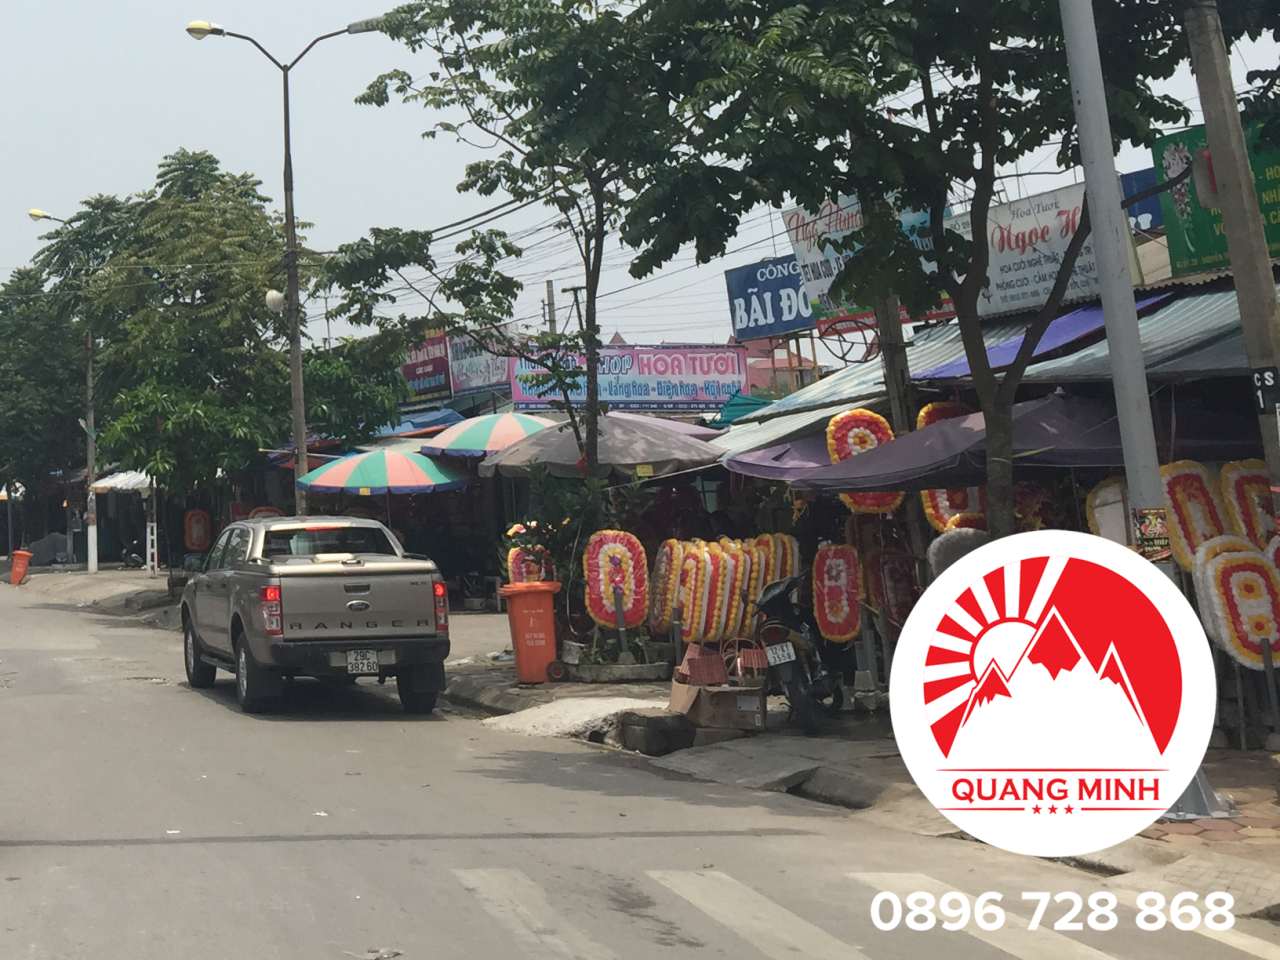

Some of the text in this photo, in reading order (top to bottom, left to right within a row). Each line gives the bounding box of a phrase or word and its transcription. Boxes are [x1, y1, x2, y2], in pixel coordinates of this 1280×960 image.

[1010, 208, 1032, 221] Hoa
[991, 223, 1052, 255] Ngọc
[756, 261, 800, 282] CÔNG
[733, 287, 775, 330] BÃI
[638, 352, 686, 376] HOA
[687, 351, 741, 376] TƯƠI
[1253, 371, 1275, 387] CS
[631, 380, 650, 396] hoa
[679, 380, 697, 396] hoa
[290, 619, 428, 630] RANGER
[354, 650, 370, 661] 29C
